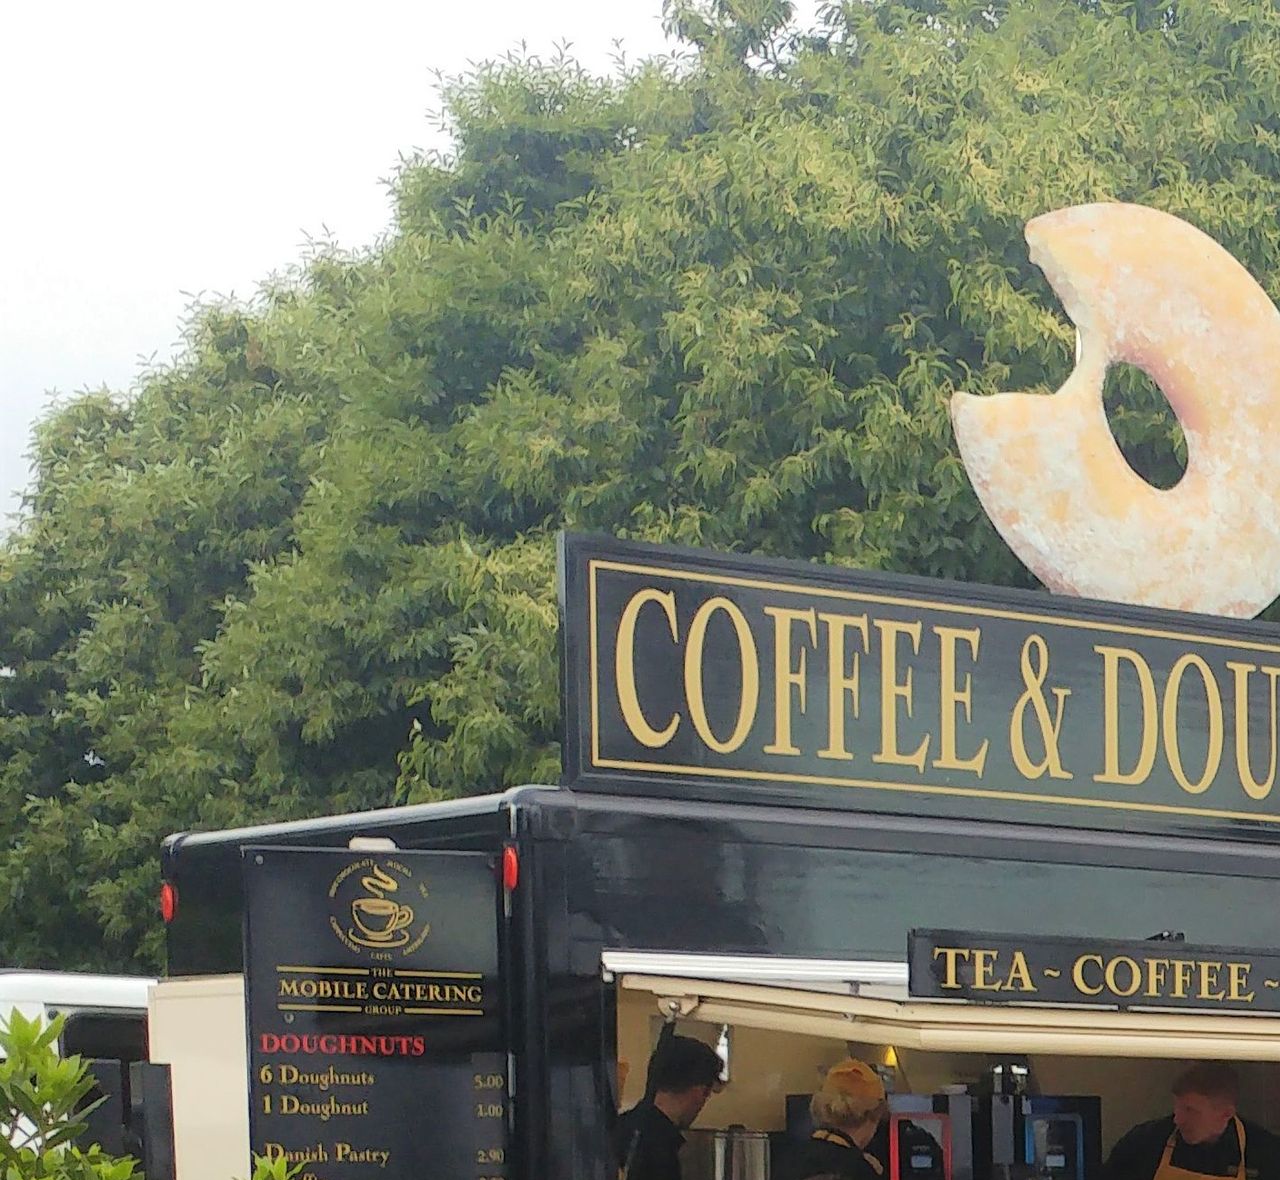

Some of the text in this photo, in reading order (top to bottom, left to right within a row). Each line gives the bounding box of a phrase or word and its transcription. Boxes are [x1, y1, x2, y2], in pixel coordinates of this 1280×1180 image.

[614, 587, 989, 776] COFFEE
[1011, 633, 1072, 781] &
[934, 946, 1034, 993] TEA
[1072, 954, 1255, 1002] COFFEE
[279, 979, 483, 1003] MOBILE CATERING
[260, 1034, 426, 1056] DOUGHNUTS
[260, 1065, 375, 1091] 6 Doughnuts
[474, 1074, 504, 1090] 5.00
[281, 1095, 368, 1121] Doughnut
[265, 1143, 390, 1168] Danish Pastry
